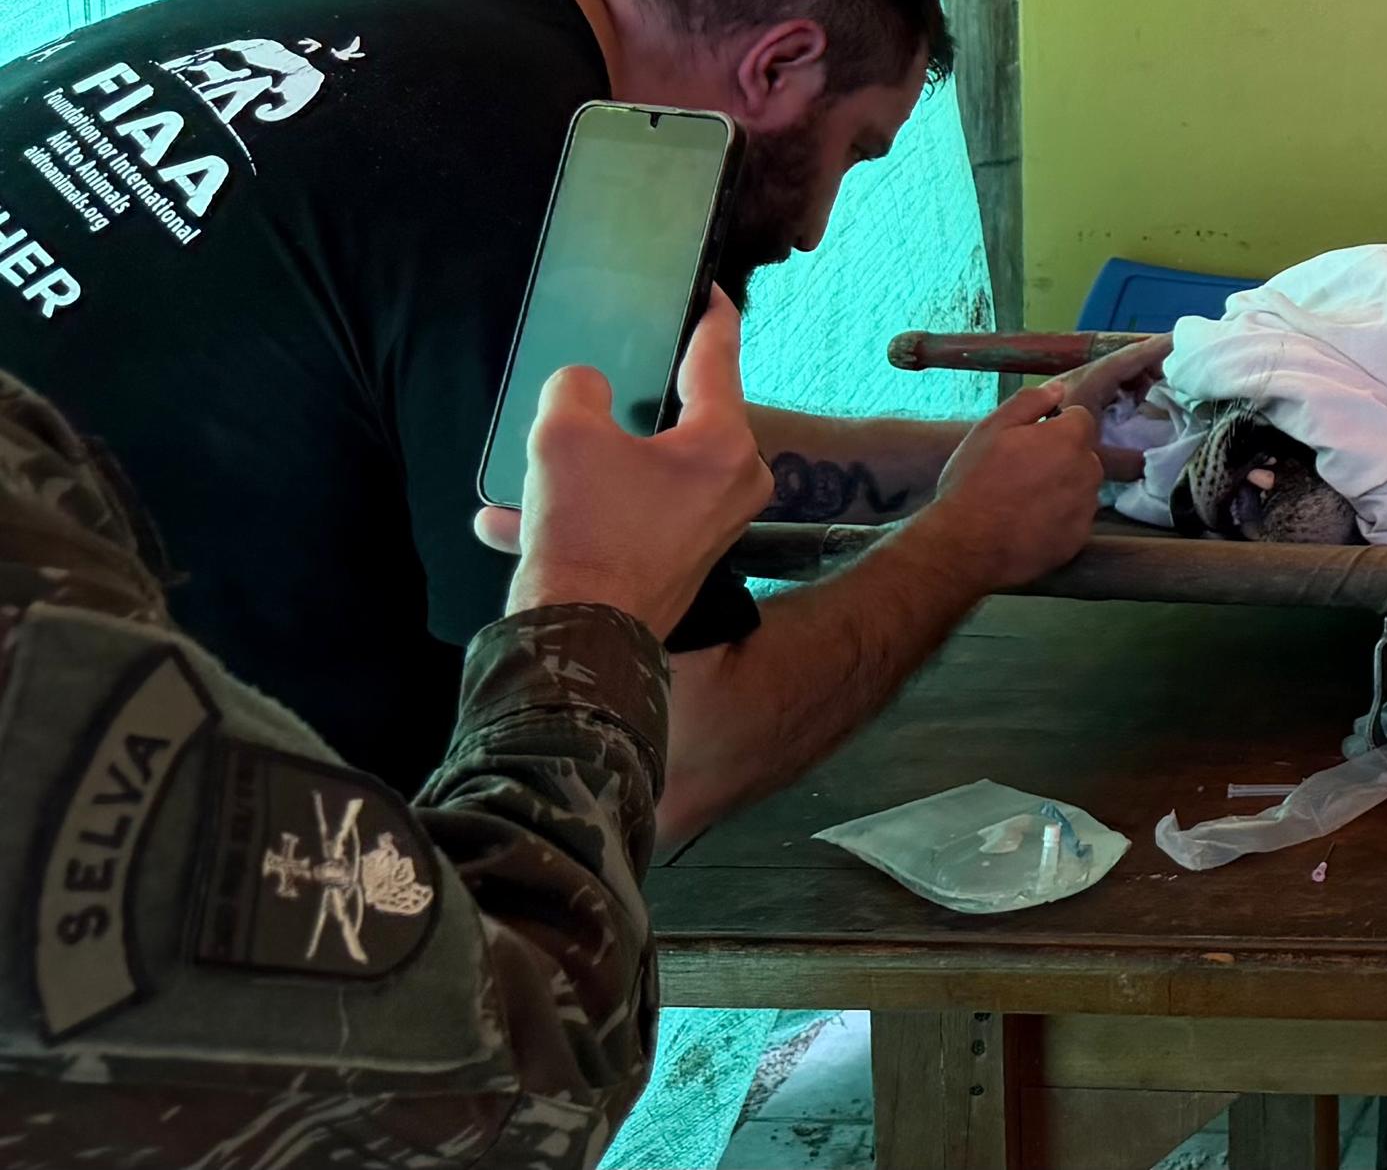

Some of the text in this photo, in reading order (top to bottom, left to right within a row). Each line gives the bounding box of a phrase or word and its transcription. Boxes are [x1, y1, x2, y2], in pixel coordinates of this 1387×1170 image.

[24, 145, 110, 233] aidtoanimals.org
[43, 87, 101, 143] Foundation
[109, 153, 201, 245] International
[47, 130, 130, 214] Aid to Animals
[72, 61, 230, 218] FIAA
[57, 731, 171, 947] SELVA
